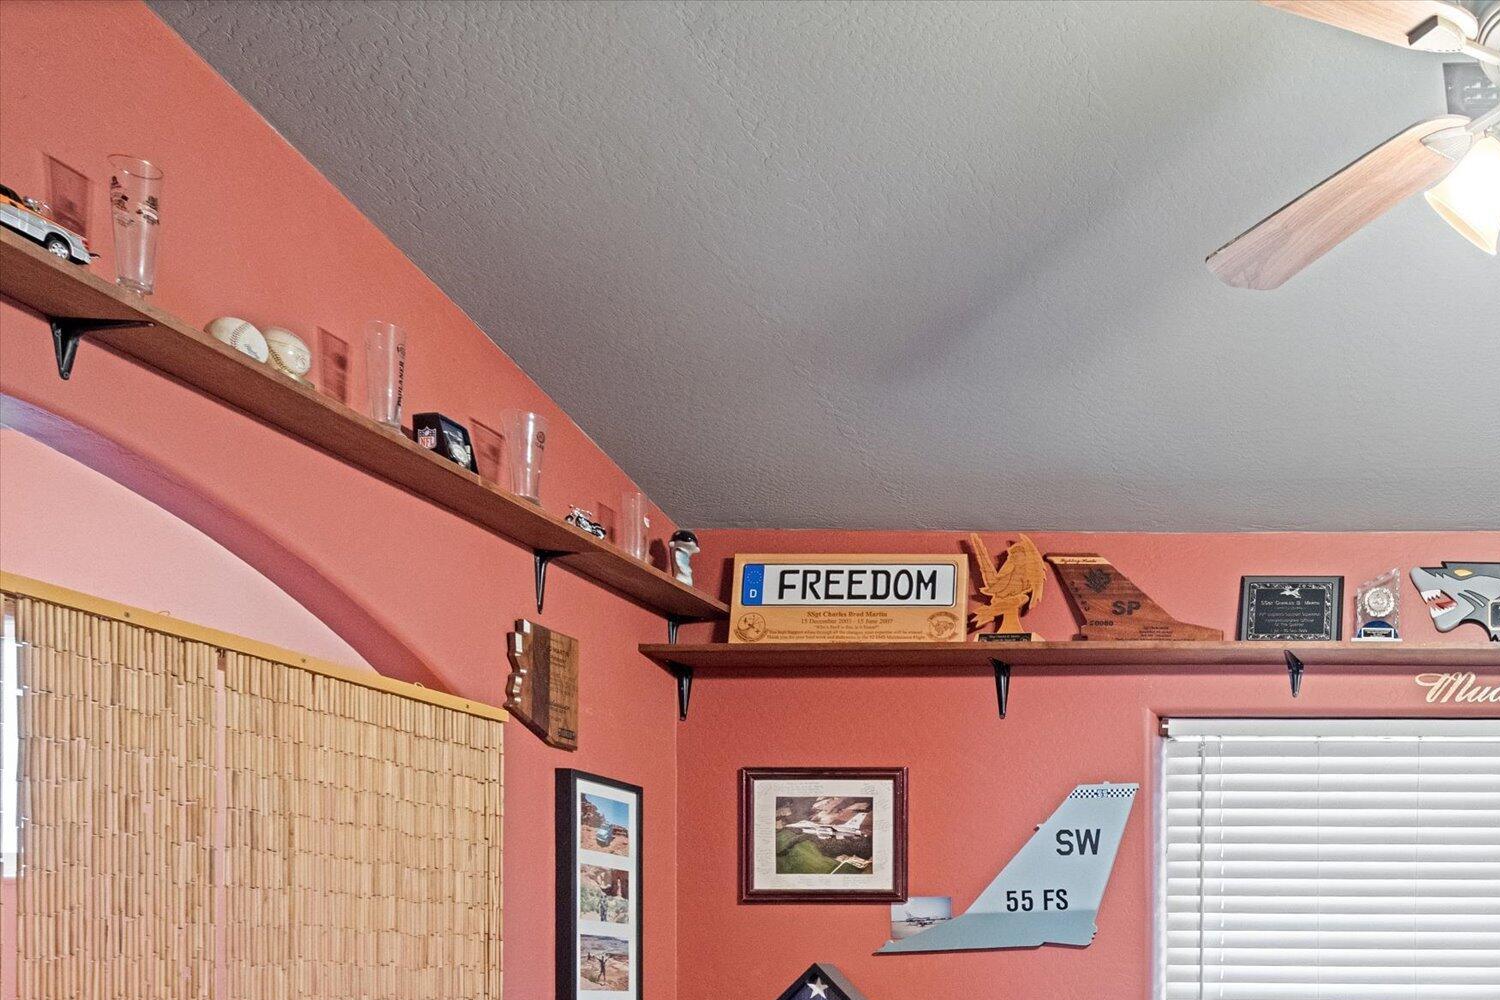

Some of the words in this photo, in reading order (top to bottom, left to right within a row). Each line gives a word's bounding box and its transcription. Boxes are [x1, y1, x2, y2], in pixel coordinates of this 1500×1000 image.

[419, 436, 437, 447] NFL
[749, 589, 757, 598] D
[778, 569, 938, 600] FREEDOM
[1111, 600, 1142, 616] SP
[1056, 828, 1101, 856] SW
[1006, 889, 1034, 912] 55
[1043, 888, 1069, 911] FS
